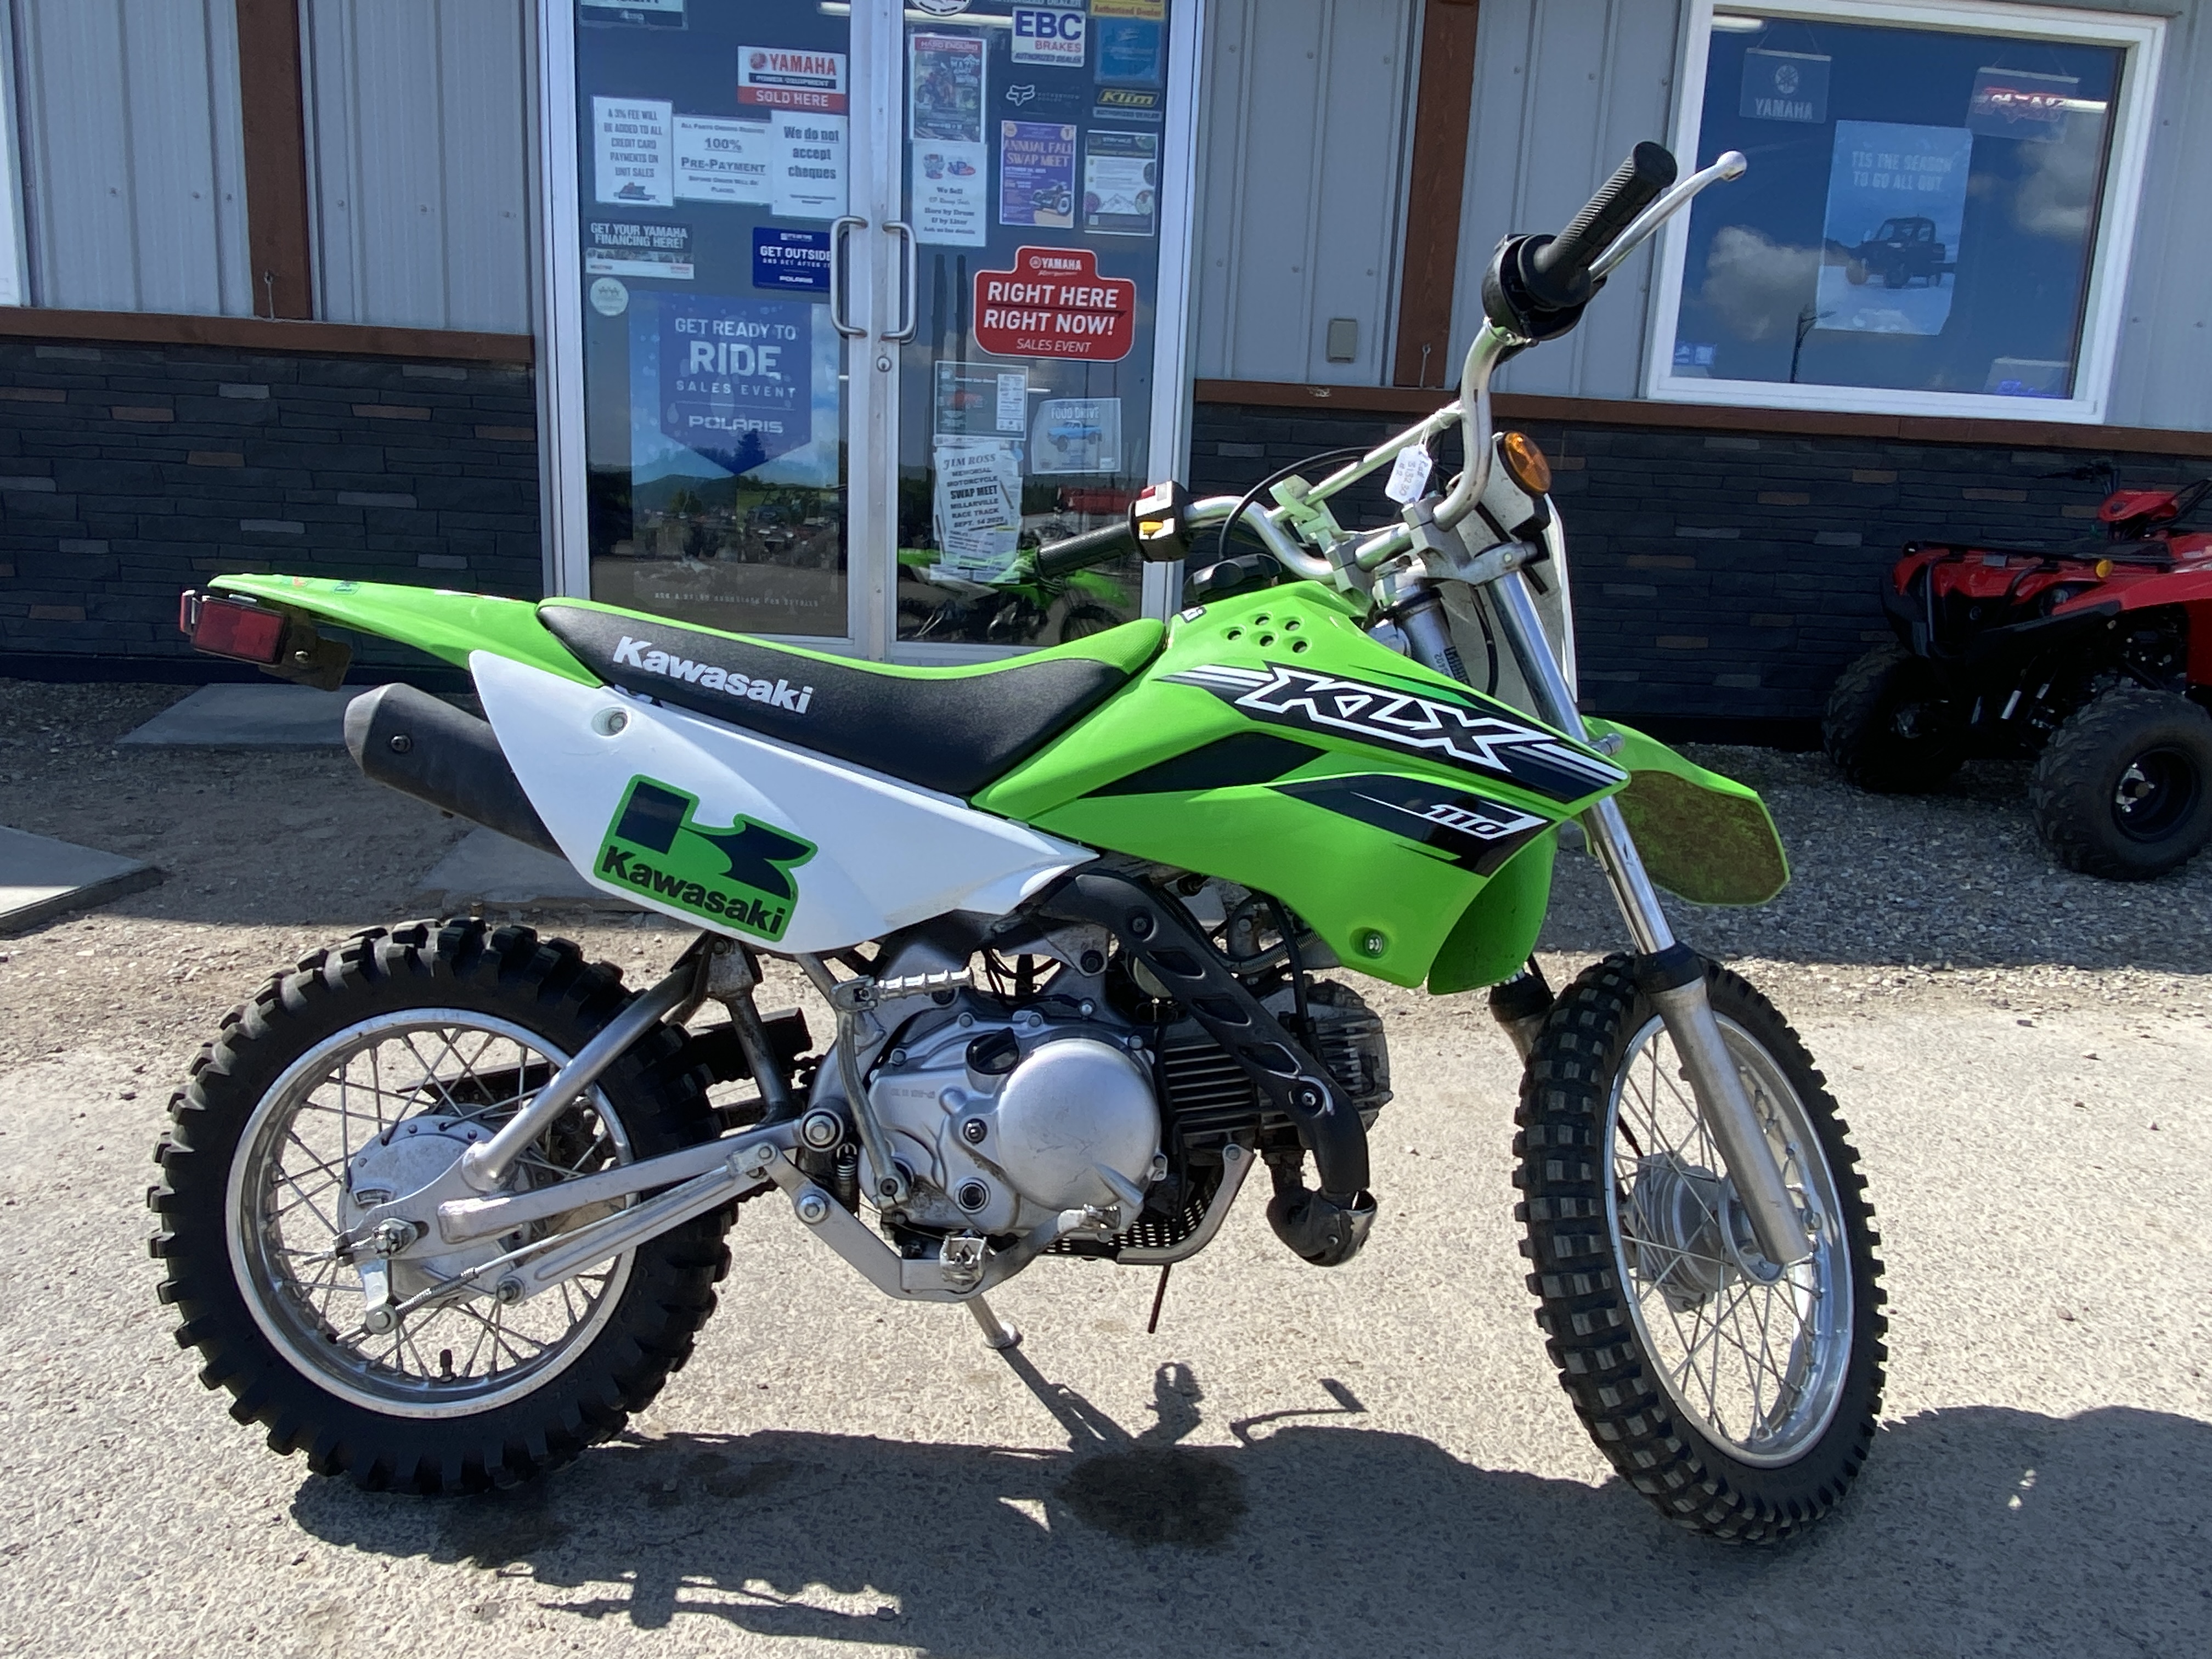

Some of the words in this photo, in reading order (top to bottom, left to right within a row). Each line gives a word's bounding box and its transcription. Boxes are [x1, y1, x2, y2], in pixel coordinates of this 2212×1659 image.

[1016, 10, 1081, 41] EBC
[1035, 40, 1081, 53] BRAKES
[769, 54, 837, 76] YAMAHA
[756, 90, 790, 104] SOLD
[794, 93, 828, 108] HERE
[641, 111, 657, 121] WILL
[1755, 97, 1813, 120] YAMAHA
[615, 123, 637, 134] ADDED
[639, 125, 649, 134] TO
[783, 126, 802, 139] We
[804, 127, 819, 140] do
[821, 129, 839, 141] not
[637, 140, 657, 149] CARD
[704, 137, 742, 151] 100%
[1003, 139, 1046, 154] ANNUAL
[1048, 142, 1073, 155] FALL
[610, 151, 647, 162] PAYMENTS
[793, 147, 832, 161] accept
[1007, 153, 1039, 165] SWAP
[1041, 155, 1070, 167] MEET
[633, 167, 654, 177] SALES
[680, 156, 766, 173] PRE-PAYMENT
[788, 165, 836, 179] cheques
[1893, 174, 1913, 190] ALL
[590, 223, 610, 234] GET
[613, 224, 640, 236] YOUR
[643, 226, 687, 238] YAMAHA
[595, 234, 650, 246] FINANCING
[653, 238, 683, 249] HERE!
[760, 245, 782, 257] GET
[785, 247, 831, 261] OUTSIDE
[1042, 257, 1082, 271] YAMAHA
[988, 281, 1056, 304] RIGHT
[1059, 285, 1119, 308] HERE
[675, 318, 708, 335] GET
[713, 320, 769, 338] READY
[774, 325, 796, 340] TO
[984, 308, 1052, 332] RIGHT
[1055, 313, 1116, 336] NOW!
[1016, 338, 1052, 351] SALES
[1054, 341, 1092, 353] EVENT
[690, 340, 782, 380] RIDE
[676, 380, 732, 394] SALES
[741, 384, 796, 398] EVENT
[1051, 407, 1073, 419] FOOD
[689, 415, 783, 434] POLARIS
[943, 458, 966, 471] JIM
[968, 453, 996, 465] ROSS
[946, 475, 998, 487] MOTORCYCLE
[950, 488, 975, 500] SWAP
[977, 485, 998, 496] MEET
[950, 498, 999, 510] MILLARVILLE
[952, 511, 972, 519] RACE
[974, 507, 1000, 516] TRACK
[612, 635, 814, 714] Kawasaki
[1234, 666, 1557, 774] KLX
[1427, 804, 1510, 839] 110
[601, 845, 786, 935] Kawasaki
